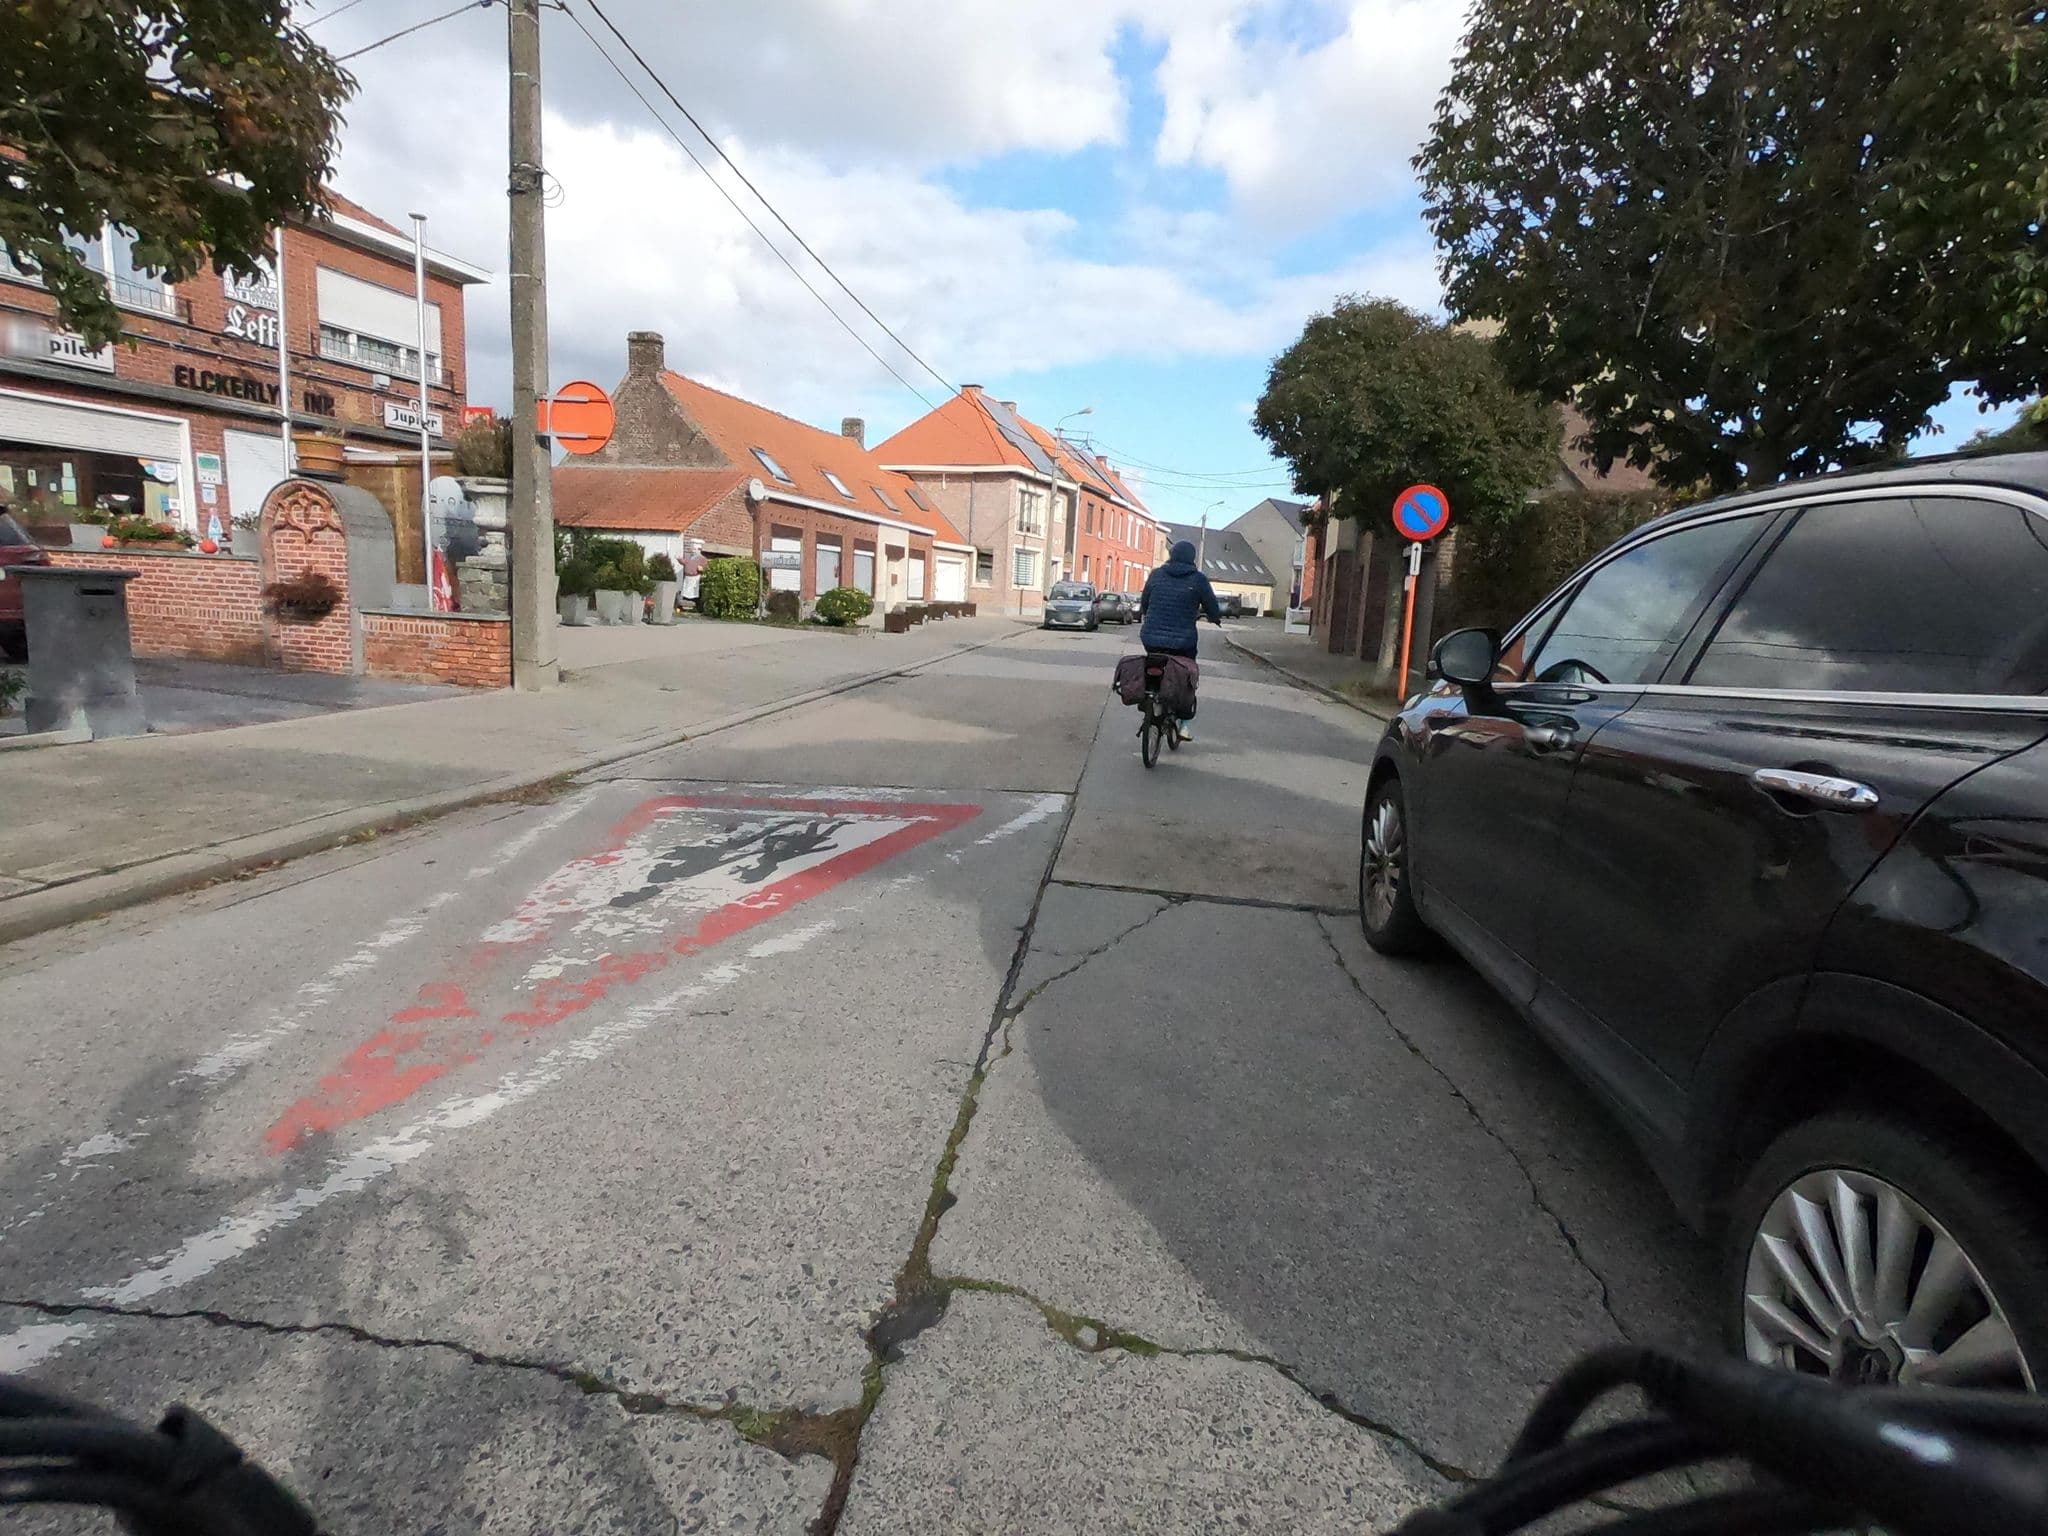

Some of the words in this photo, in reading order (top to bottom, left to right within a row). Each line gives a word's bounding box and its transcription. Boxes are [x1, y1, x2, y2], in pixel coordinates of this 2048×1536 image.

[223, 305, 280, 347] Leff
[174, 364, 291, 409] ELCKERLY
[391, 408, 438, 428] Jupier
